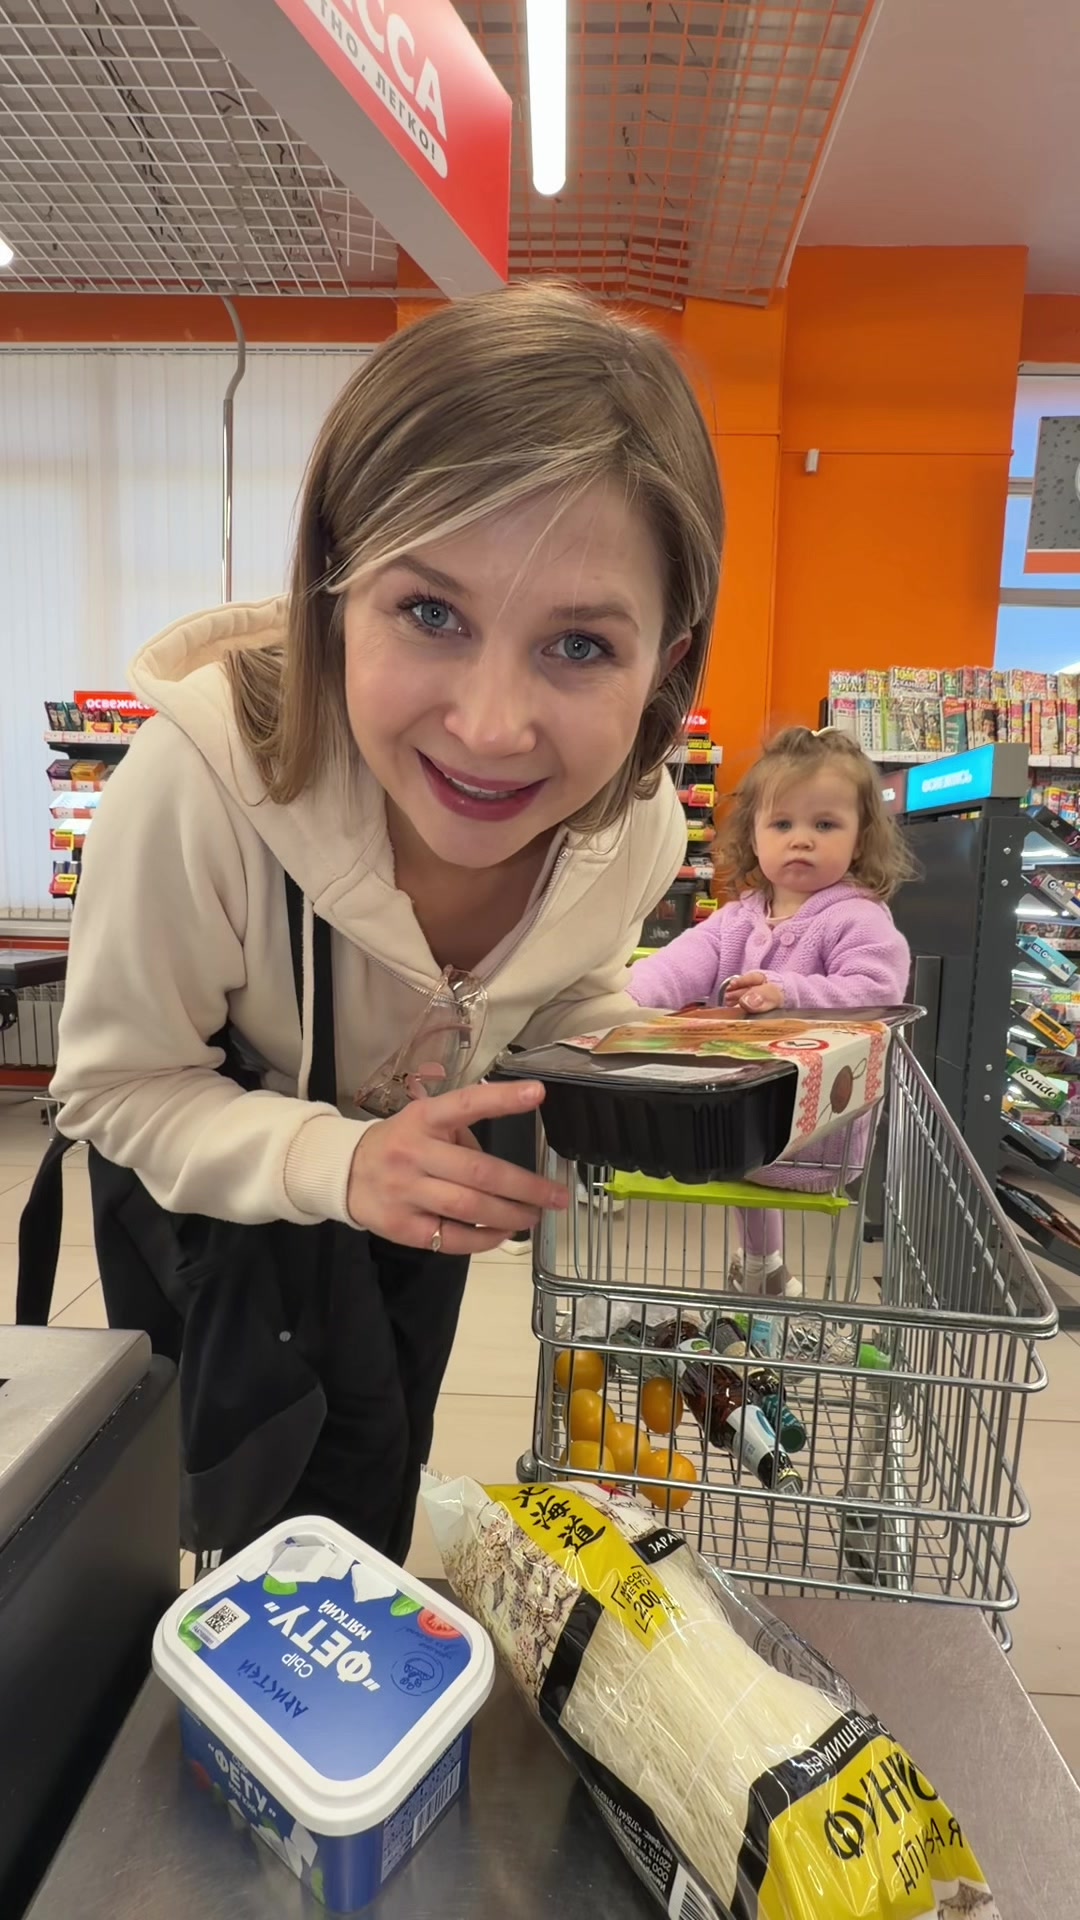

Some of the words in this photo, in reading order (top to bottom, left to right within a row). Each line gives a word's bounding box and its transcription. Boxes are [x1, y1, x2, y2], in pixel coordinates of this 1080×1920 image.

[375, 72, 435, 160] ЛЕГКО!
[1016, 1067, 1057, 1099] Rondo
[317, 1599, 372, 1641] МЯГКИЙ
[281, 1653, 313, 1678] СЫР
[652, 1863, 668, 1882] ООО
